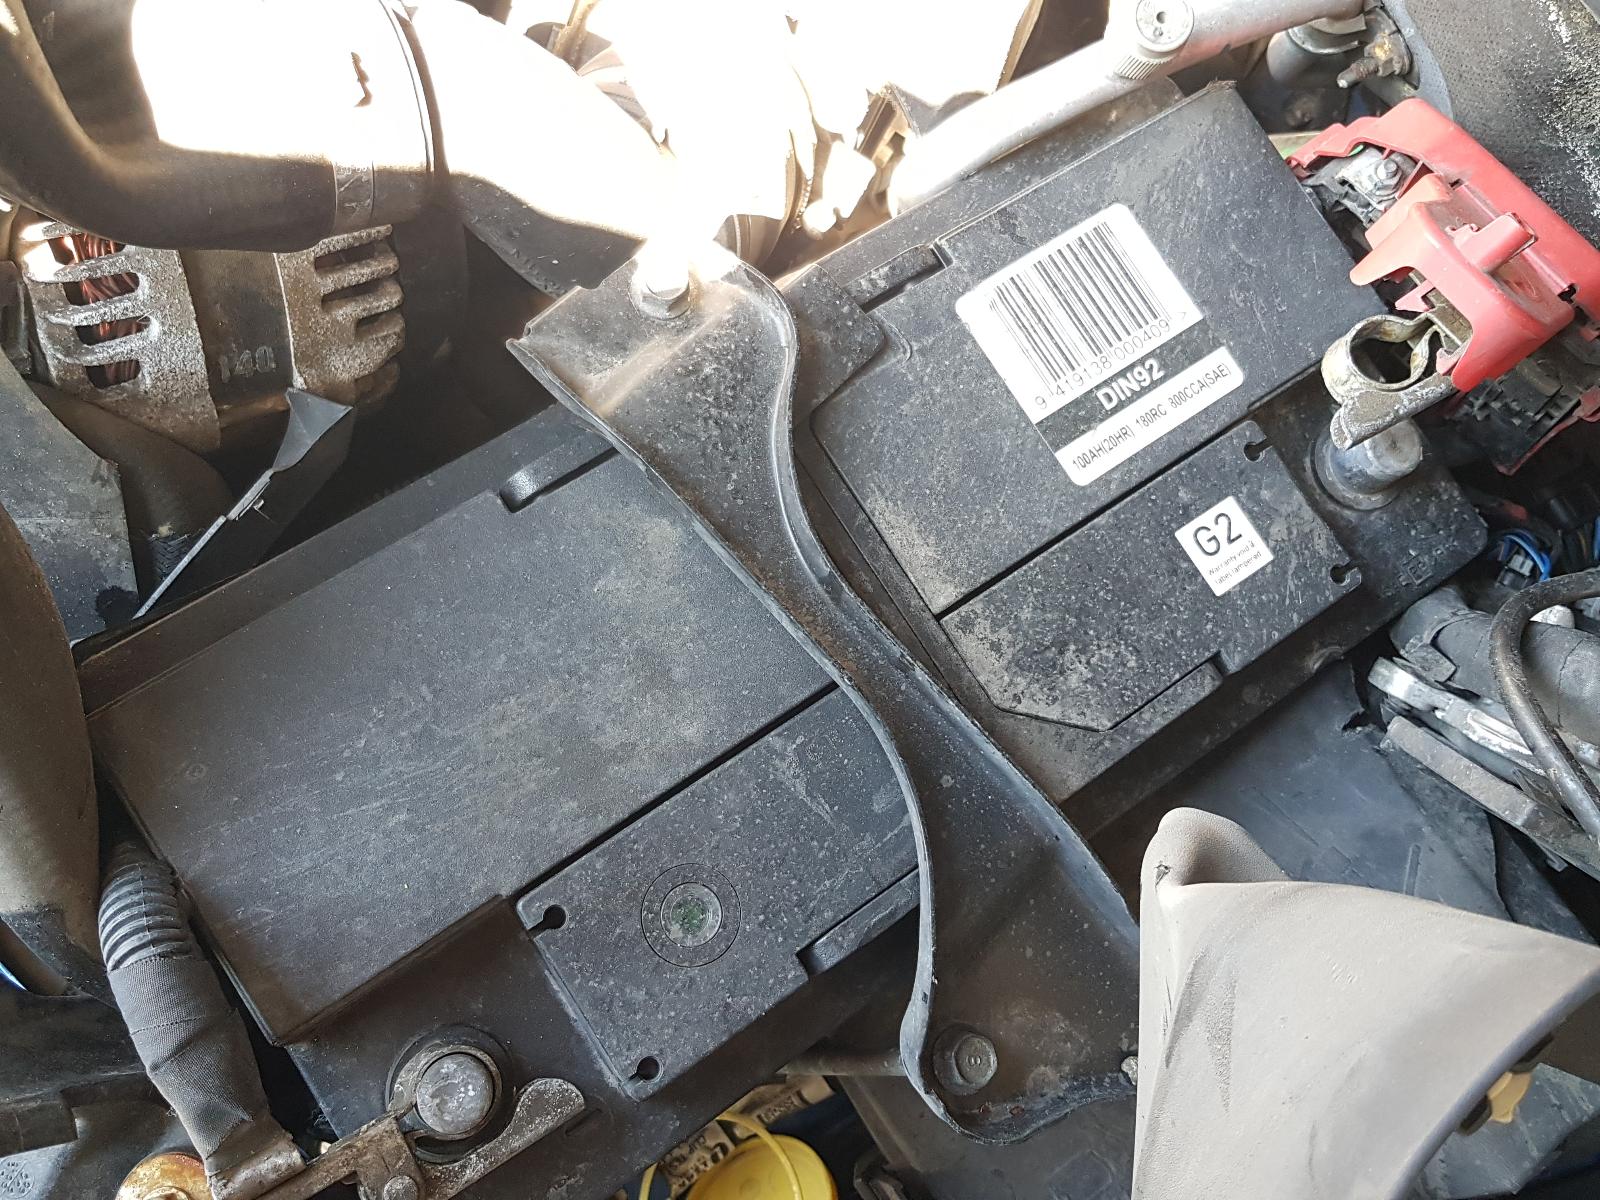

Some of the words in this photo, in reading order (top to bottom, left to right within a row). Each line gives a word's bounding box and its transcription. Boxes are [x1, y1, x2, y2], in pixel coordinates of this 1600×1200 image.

[1055, 355, 1112, 395] 419138
[1113, 319, 1170, 360] 000409
[1096, 358, 1166, 411] DIN92
[1072, 424, 1136, 471] 100AH(20HR)
[1135, 403, 1167, 429] 180RC
[1193, 512, 1243, 557] G2
